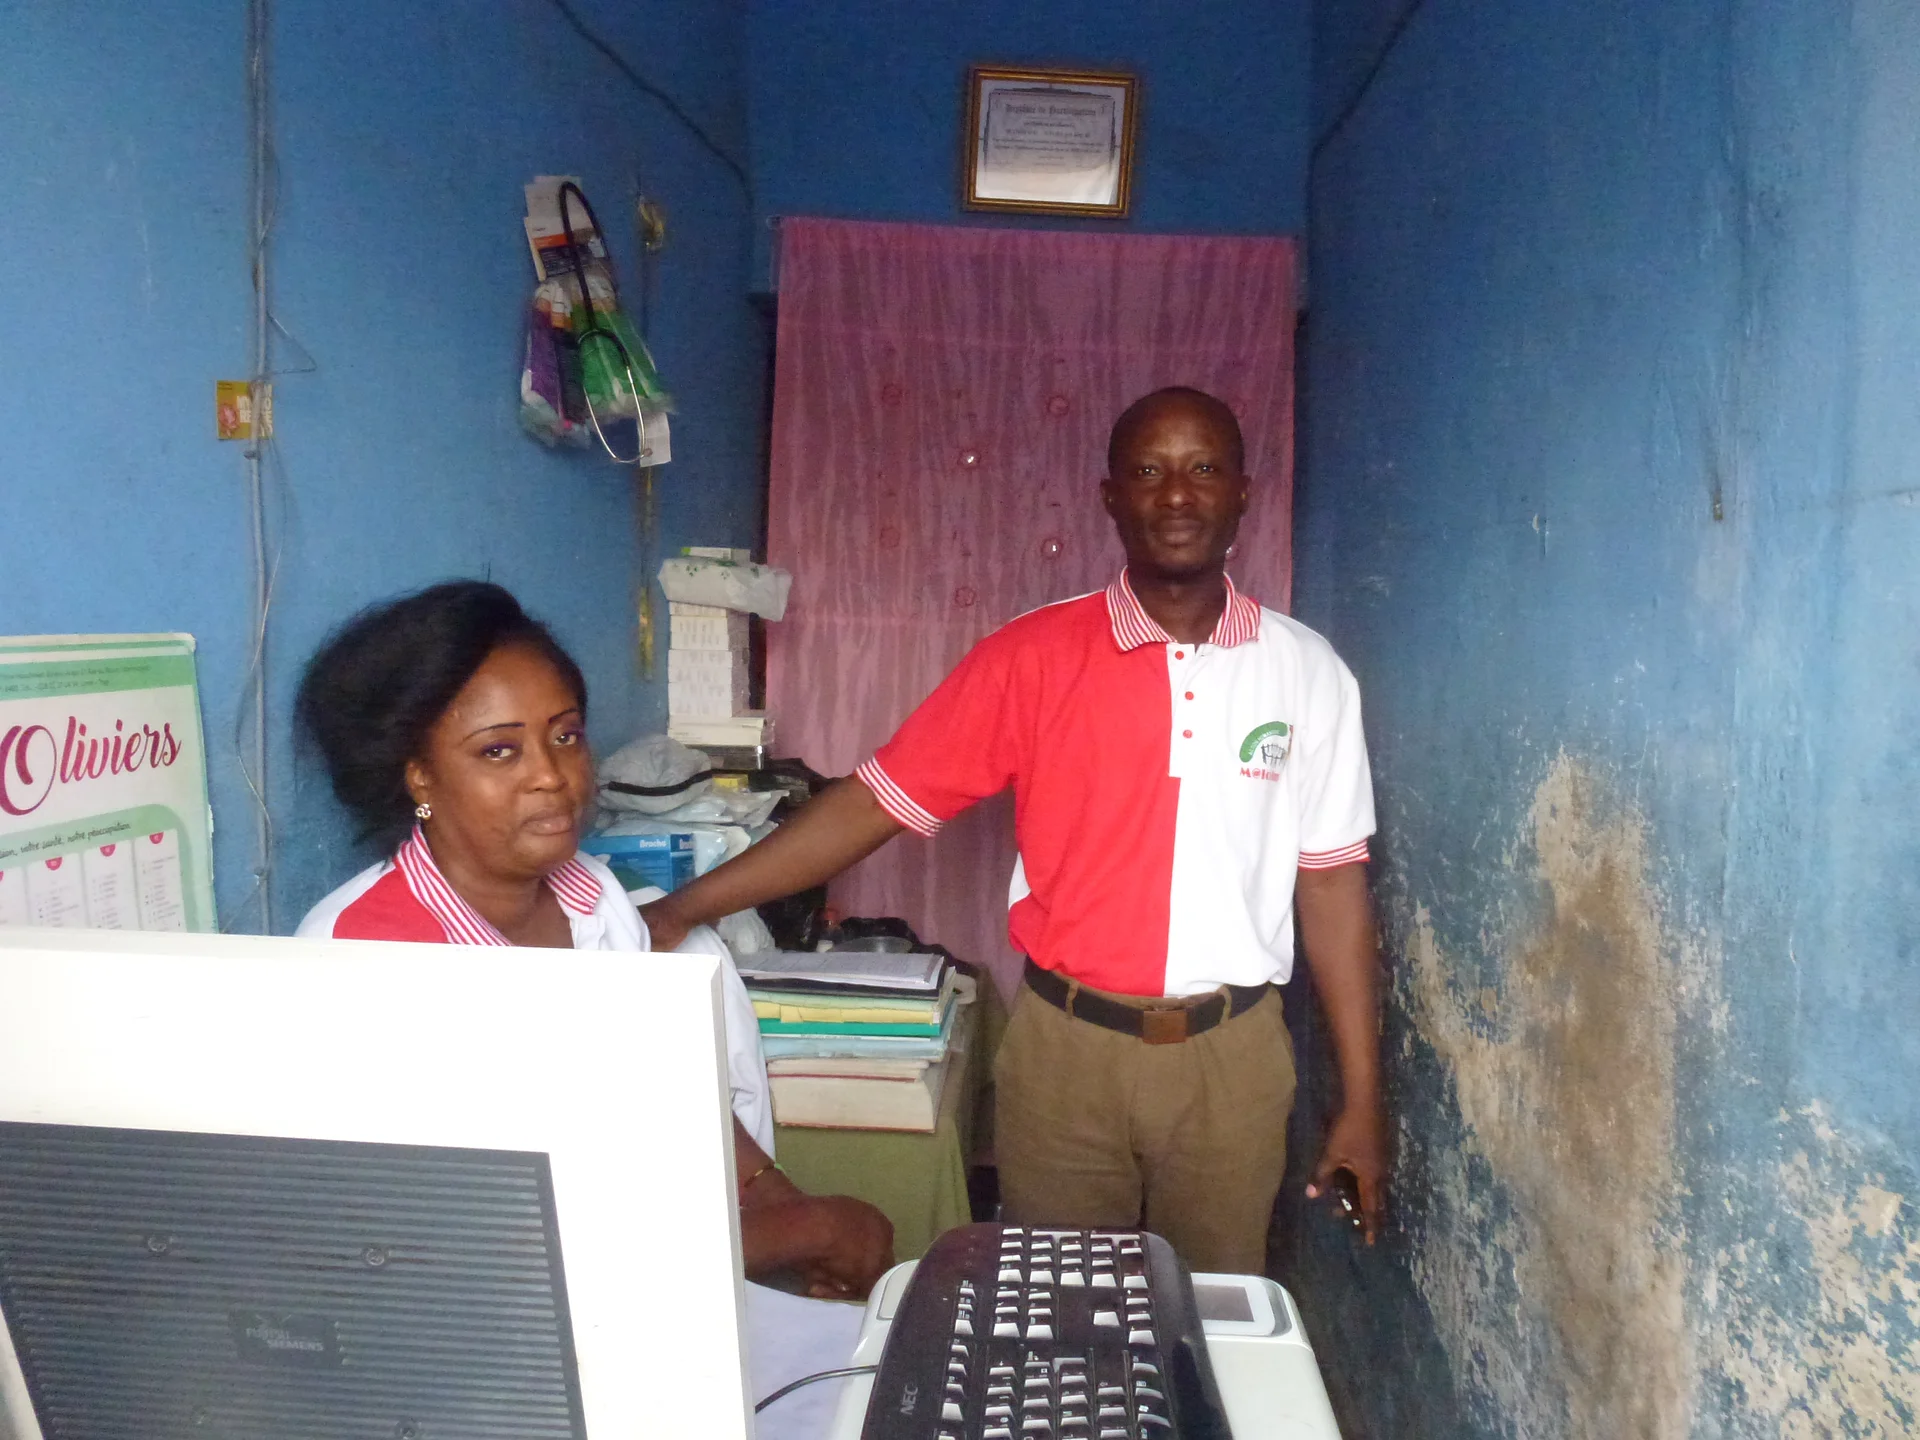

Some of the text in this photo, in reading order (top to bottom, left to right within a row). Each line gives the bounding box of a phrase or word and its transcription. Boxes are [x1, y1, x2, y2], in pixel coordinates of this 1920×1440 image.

[0, 716, 182, 816] Oliviers
[267, 1339, 324, 1352] SIEMENS
[900, 1384, 919, 1416] NEC
